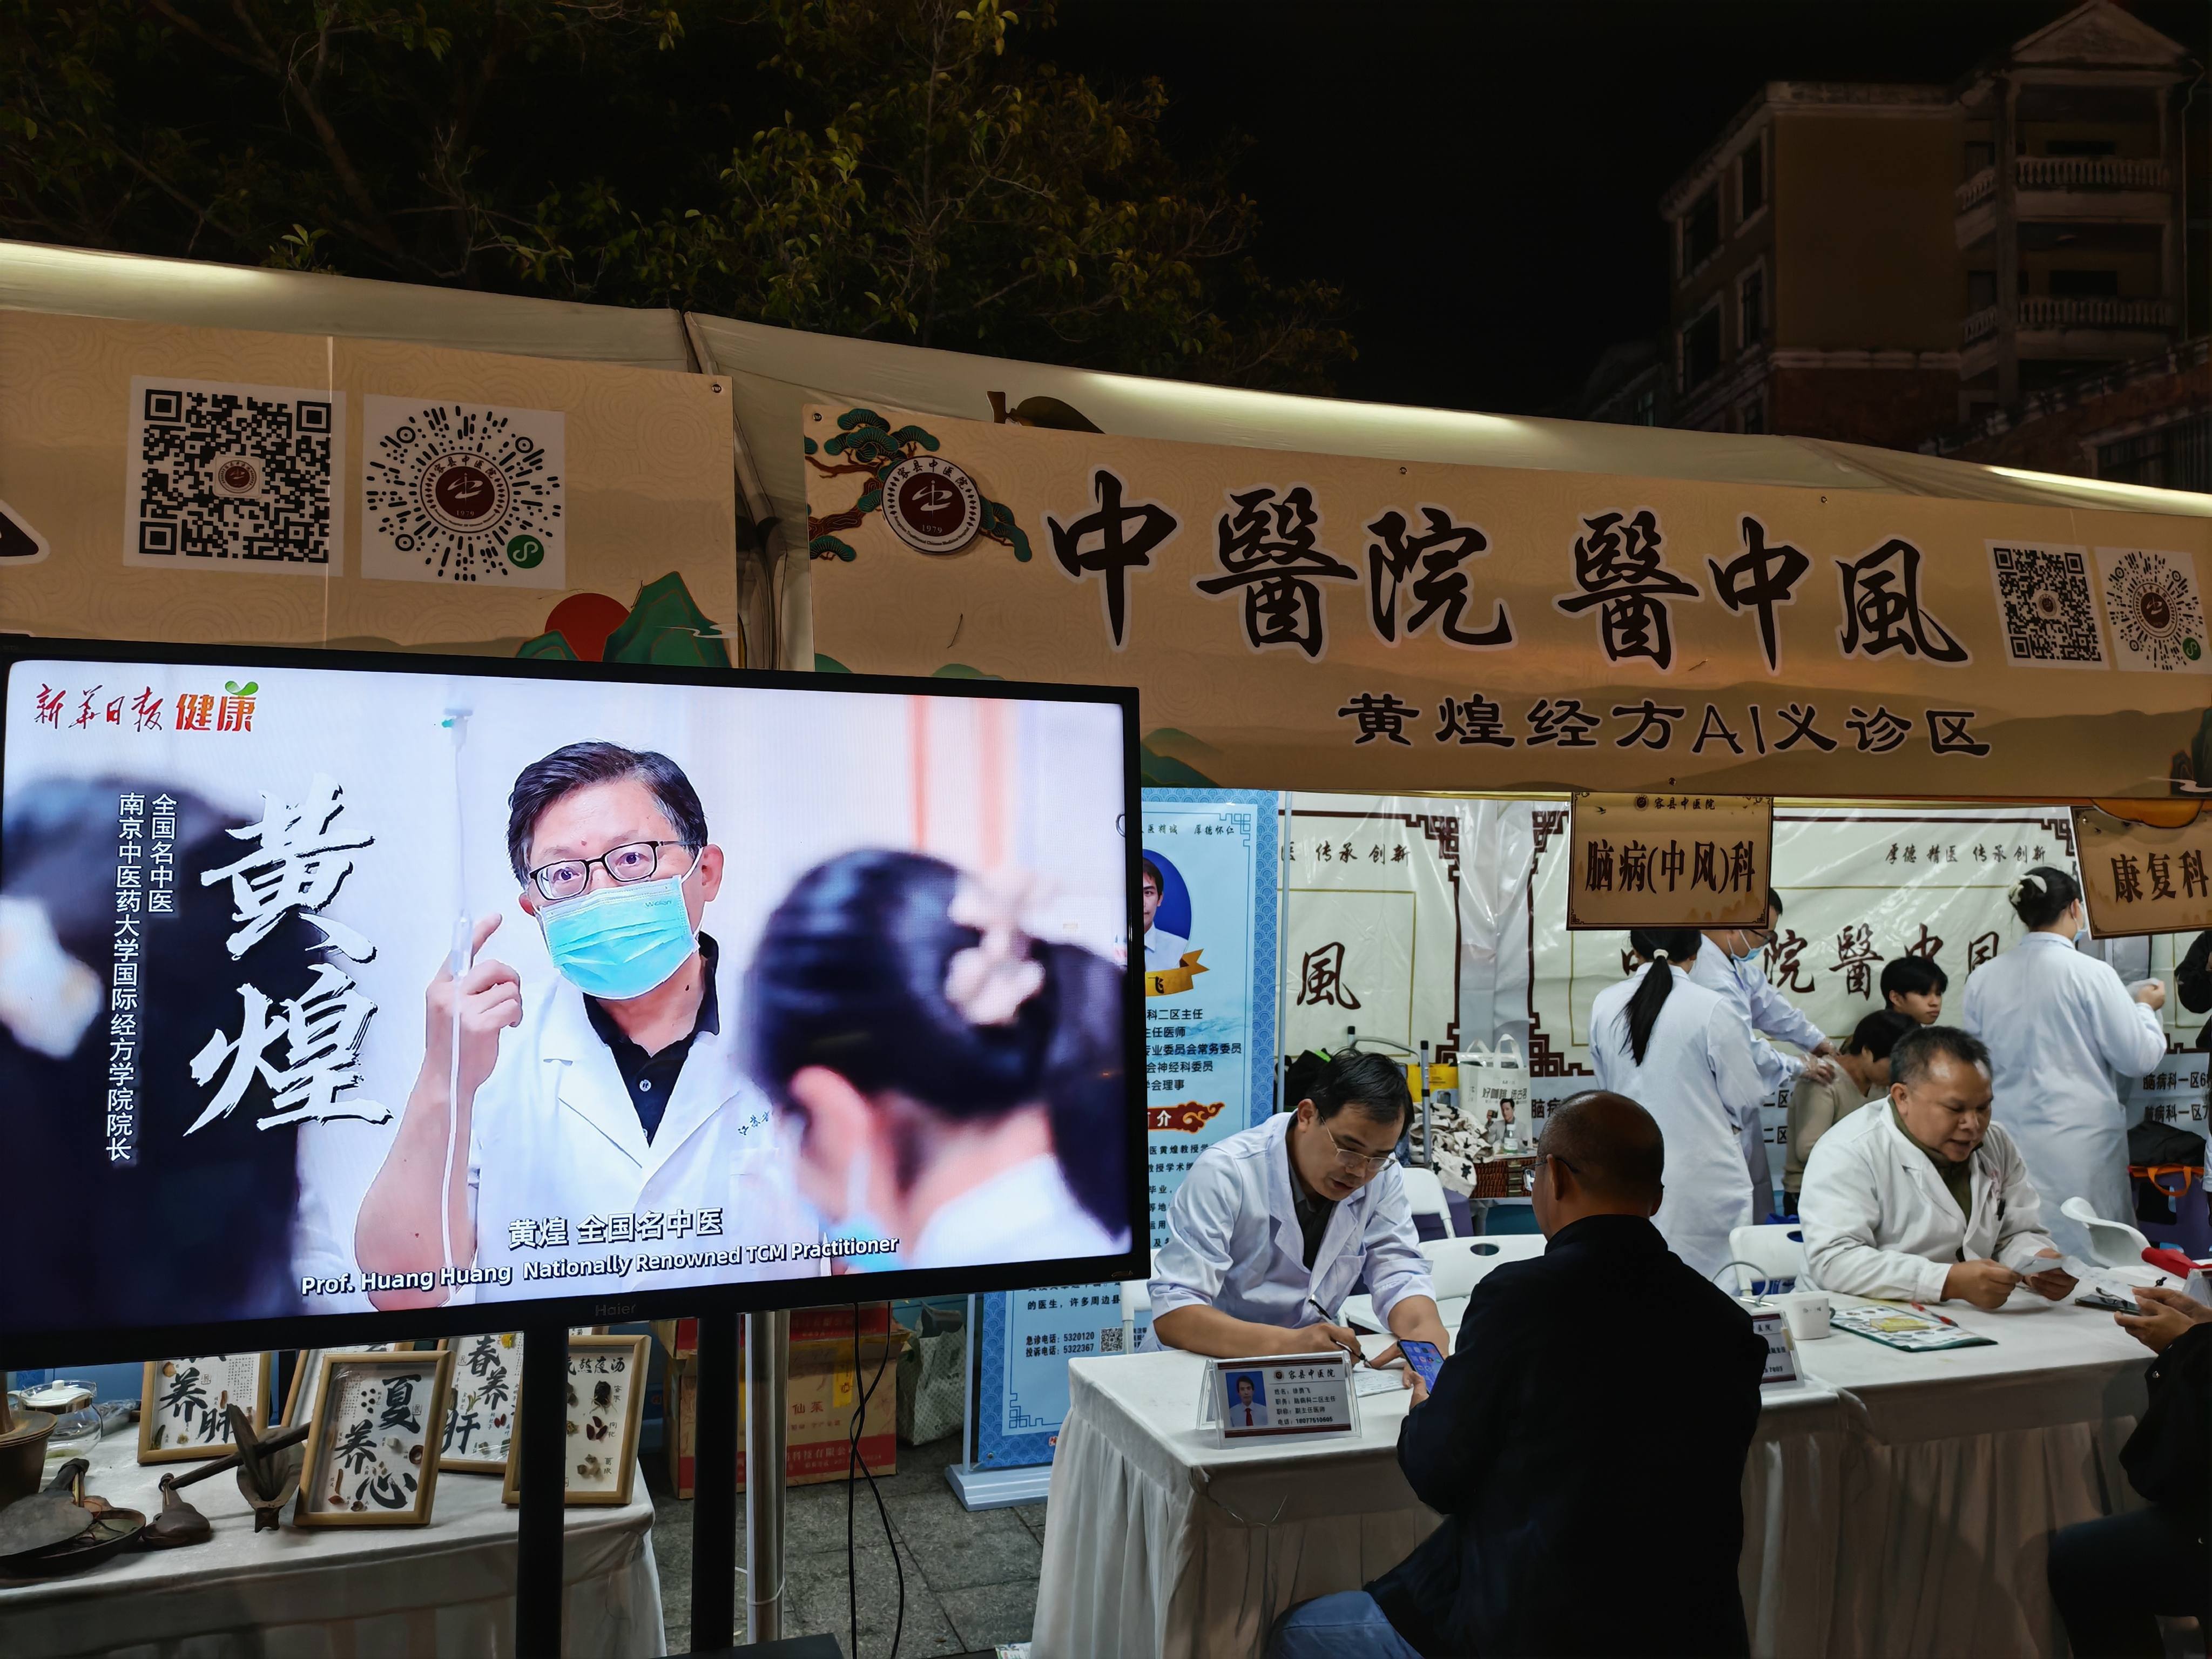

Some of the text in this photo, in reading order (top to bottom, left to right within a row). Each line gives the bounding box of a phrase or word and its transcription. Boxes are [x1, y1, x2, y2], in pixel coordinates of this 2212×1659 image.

[897, 458, 968, 490] 容县中医院
[921, 524, 943, 534] 1979
[1048, 469, 1969, 671] 中醫院 醫中風
[1338, 692, 1991, 757] 黄煌经方AI义诊区
[1654, 797, 1716, 811] 容县中医院
[148, 793, 177, 913] 全国名中医
[1316, 840, 1358, 863] 传承
[1368, 844, 1411, 866] 创新
[1585, 839, 1755, 894] 脑病(中风)科
[1973, 843, 2007, 863] 传承
[2013, 845, 2046, 865] 创新
[2110, 849, 2209, 903] 康复科
[183, 772, 394, 1137] 黄煌
[106, 792, 145, 1162] 南京中医药大学国际经方学院院长
[1148, 976, 1164, 994] 飞
[1297, 941, 1361, 1010] 風
[1147, 1008, 1204, 1021] 科二区主任
[1147, 1060, 1214, 1073] 会神经科委员
[508, 1207, 723, 1251] 黄煌 全国名中医
[301, 1236, 900, 1296] Prof. Huang Huang Nationally Renowned TCM Practitioner
[595, 1303, 636, 1317] Haier
[1288, 1368, 1336, 1380] 容县中医院
